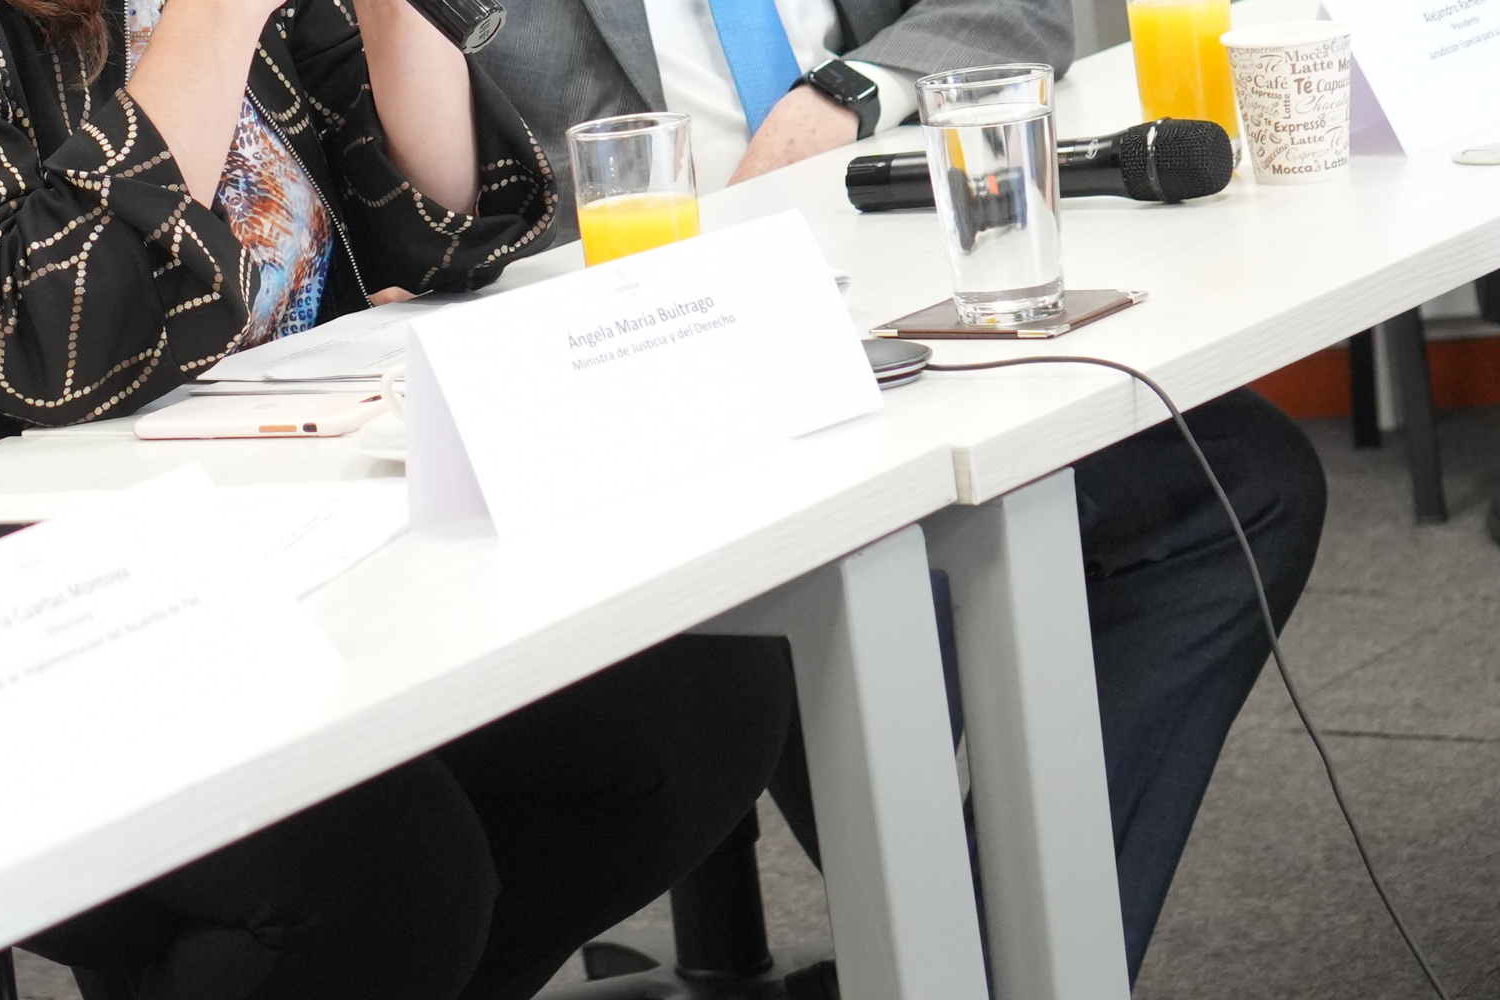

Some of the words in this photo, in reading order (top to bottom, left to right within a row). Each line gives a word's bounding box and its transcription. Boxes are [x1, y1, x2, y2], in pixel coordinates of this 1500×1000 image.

[1423, 4, 1460, 23] Alejandro
[1284, 50, 1328, 63] Mocca
[1290, 60, 1333, 75] Latte
[1254, 74, 1288, 89] Café
[1293, 76, 1313, 95] Té
[1251, 87, 1282, 100] Expresso
[1283, 93, 1291, 119] Latte
[1246, 124, 1268, 145] Café
[1274, 119, 1326, 136] Expresso
[1290, 135, 1325, 146] Latte
[1271, 164, 1313, 175] Mocca
[568, 324, 615, 350] Ángela
[615, 312, 657, 336] María
[656, 296, 714, 323] Buitrago
[571, 350, 616, 371] Ministra
[616, 345, 630, 358] de
[631, 334, 668, 354] Justicia
[669, 332, 676, 344] y
[677, 324, 694, 340] del
[694, 313, 736, 334] Derecho
